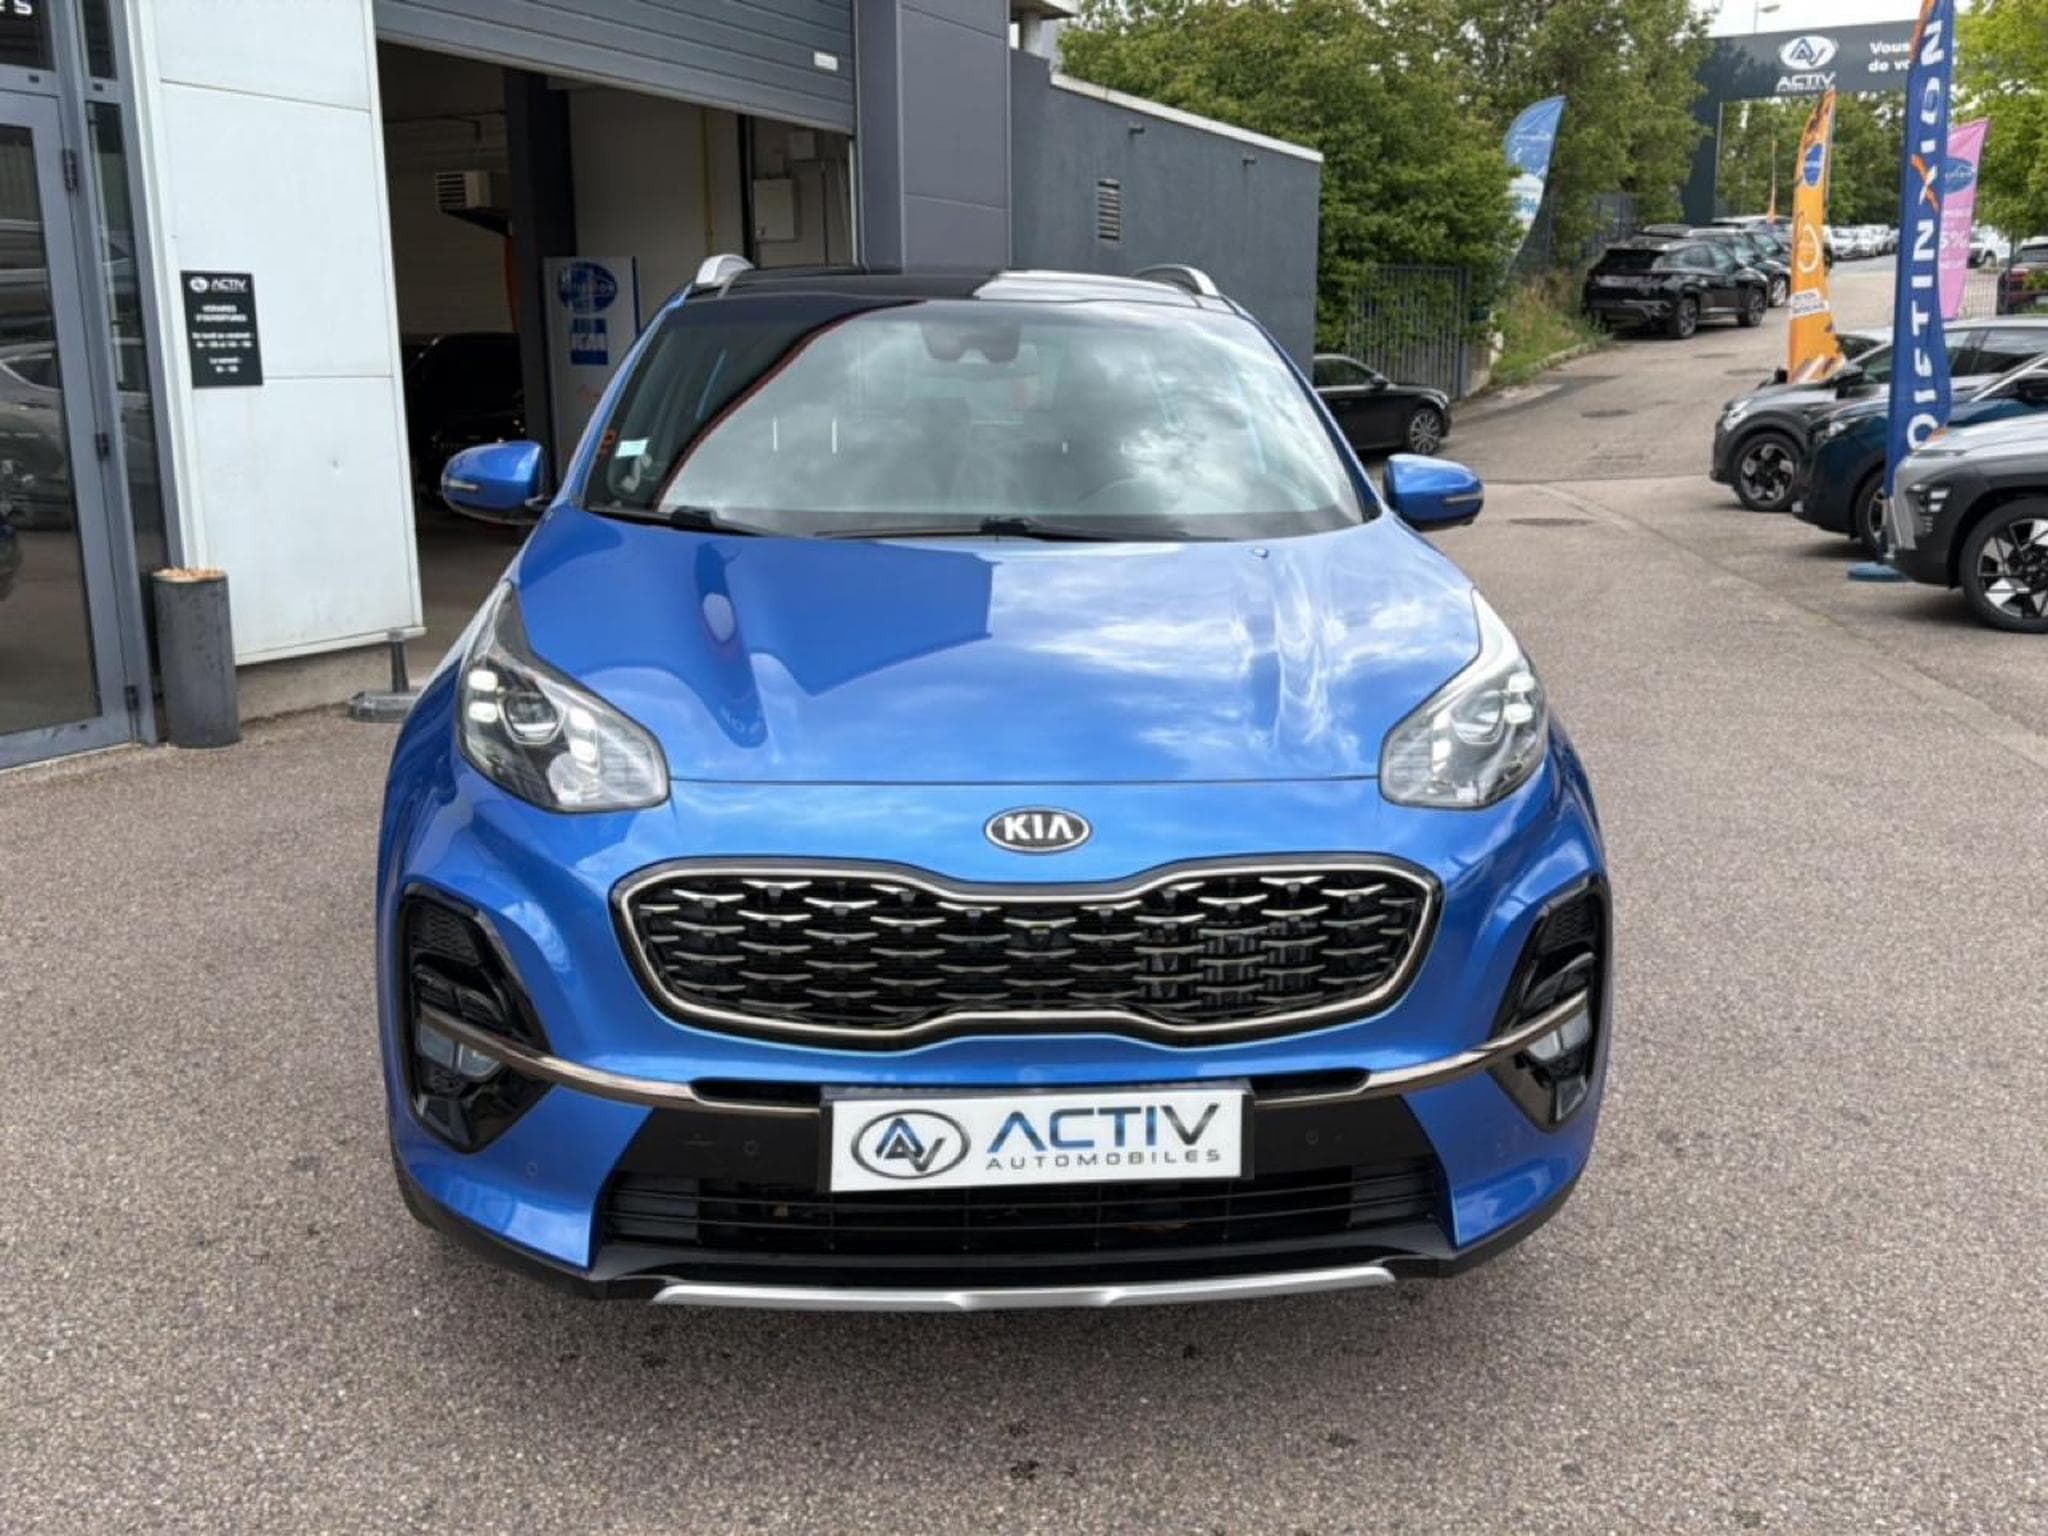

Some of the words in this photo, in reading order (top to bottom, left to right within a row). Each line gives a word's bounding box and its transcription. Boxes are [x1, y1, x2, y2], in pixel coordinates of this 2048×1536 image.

[1868, 60, 1889, 72] de
[1776, 71, 1836, 89] ACTIV
[1003, 813, 1075, 841] KIA
[986, 1103, 1220, 1154] ACTIV
[986, 1148, 1221, 1171] AUTOMOBILES
